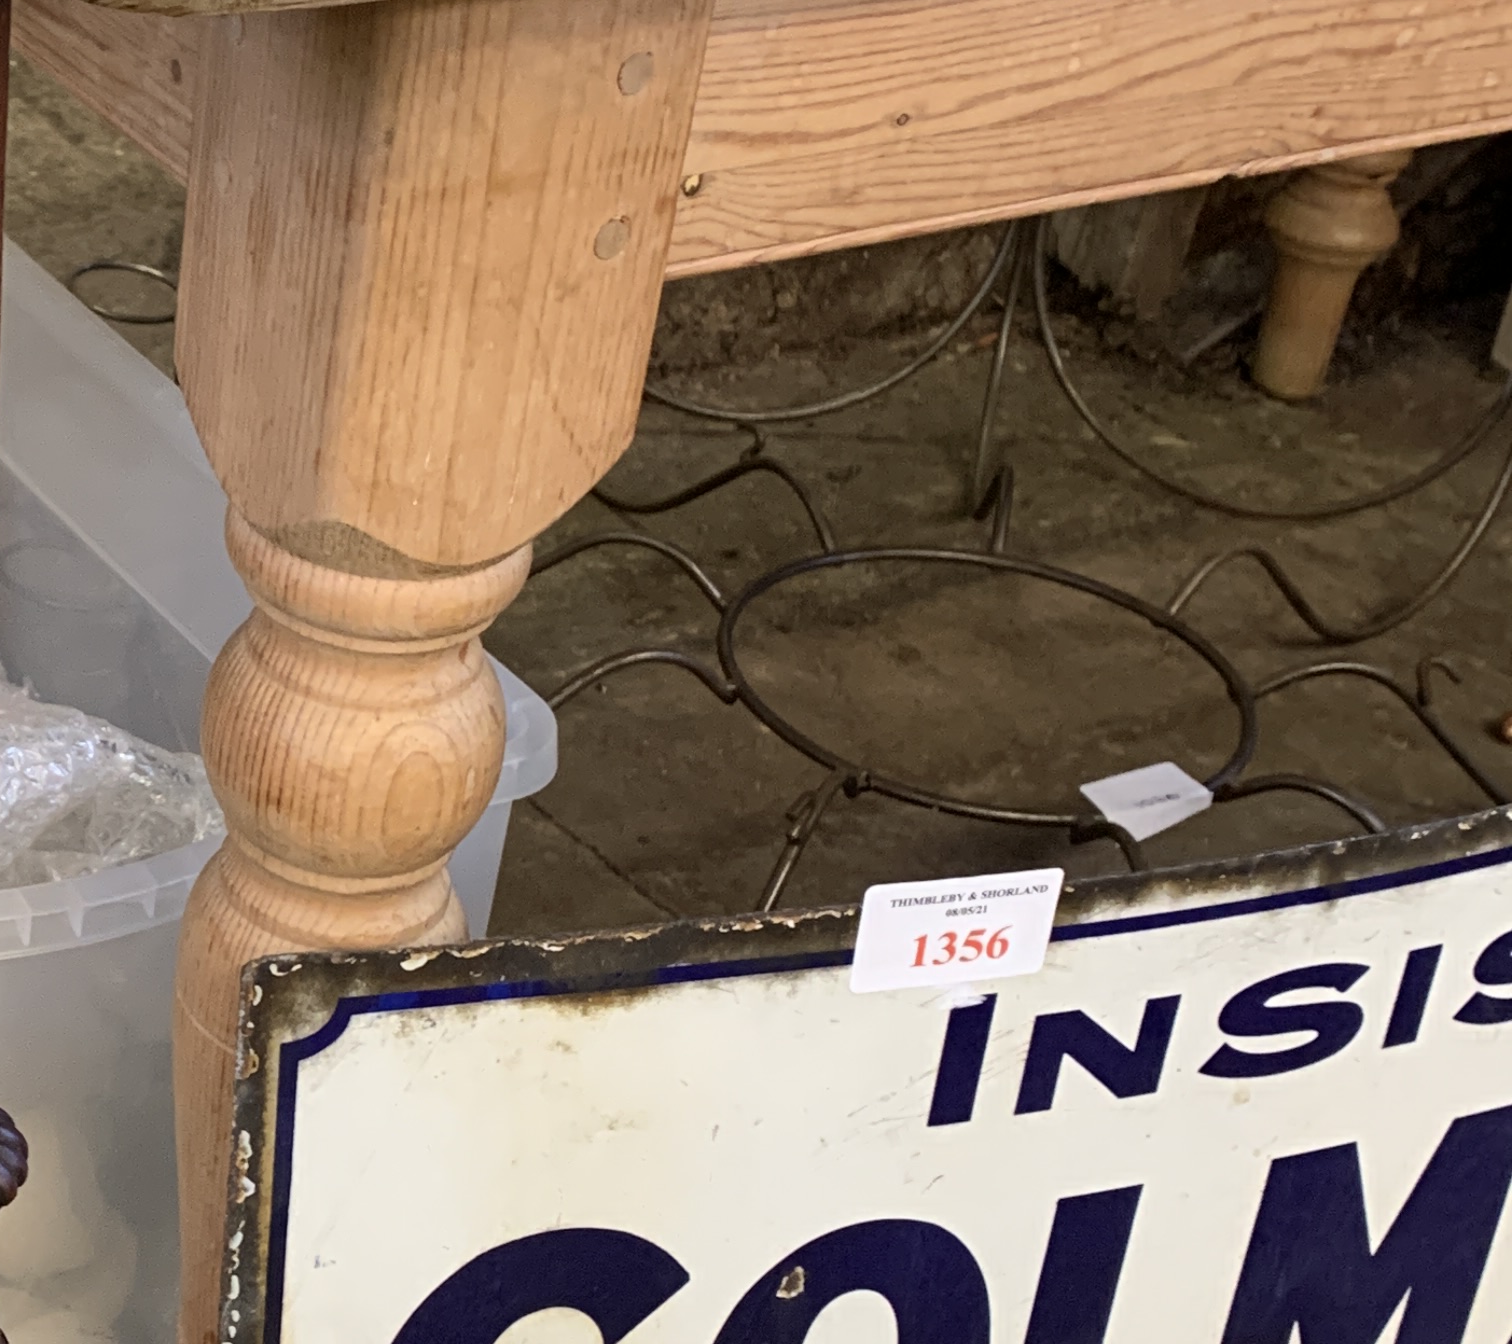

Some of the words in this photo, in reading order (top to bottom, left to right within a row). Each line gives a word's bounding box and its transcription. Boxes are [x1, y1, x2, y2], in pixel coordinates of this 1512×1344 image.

[890, 892, 966, 908] THIMBLEBY
[967, 891, 978, 902] &
[980, 884, 1049, 900] SHORLAND
[945, 904, 988, 918] 08/05/21
[910, 924, 1014, 968] 1356
